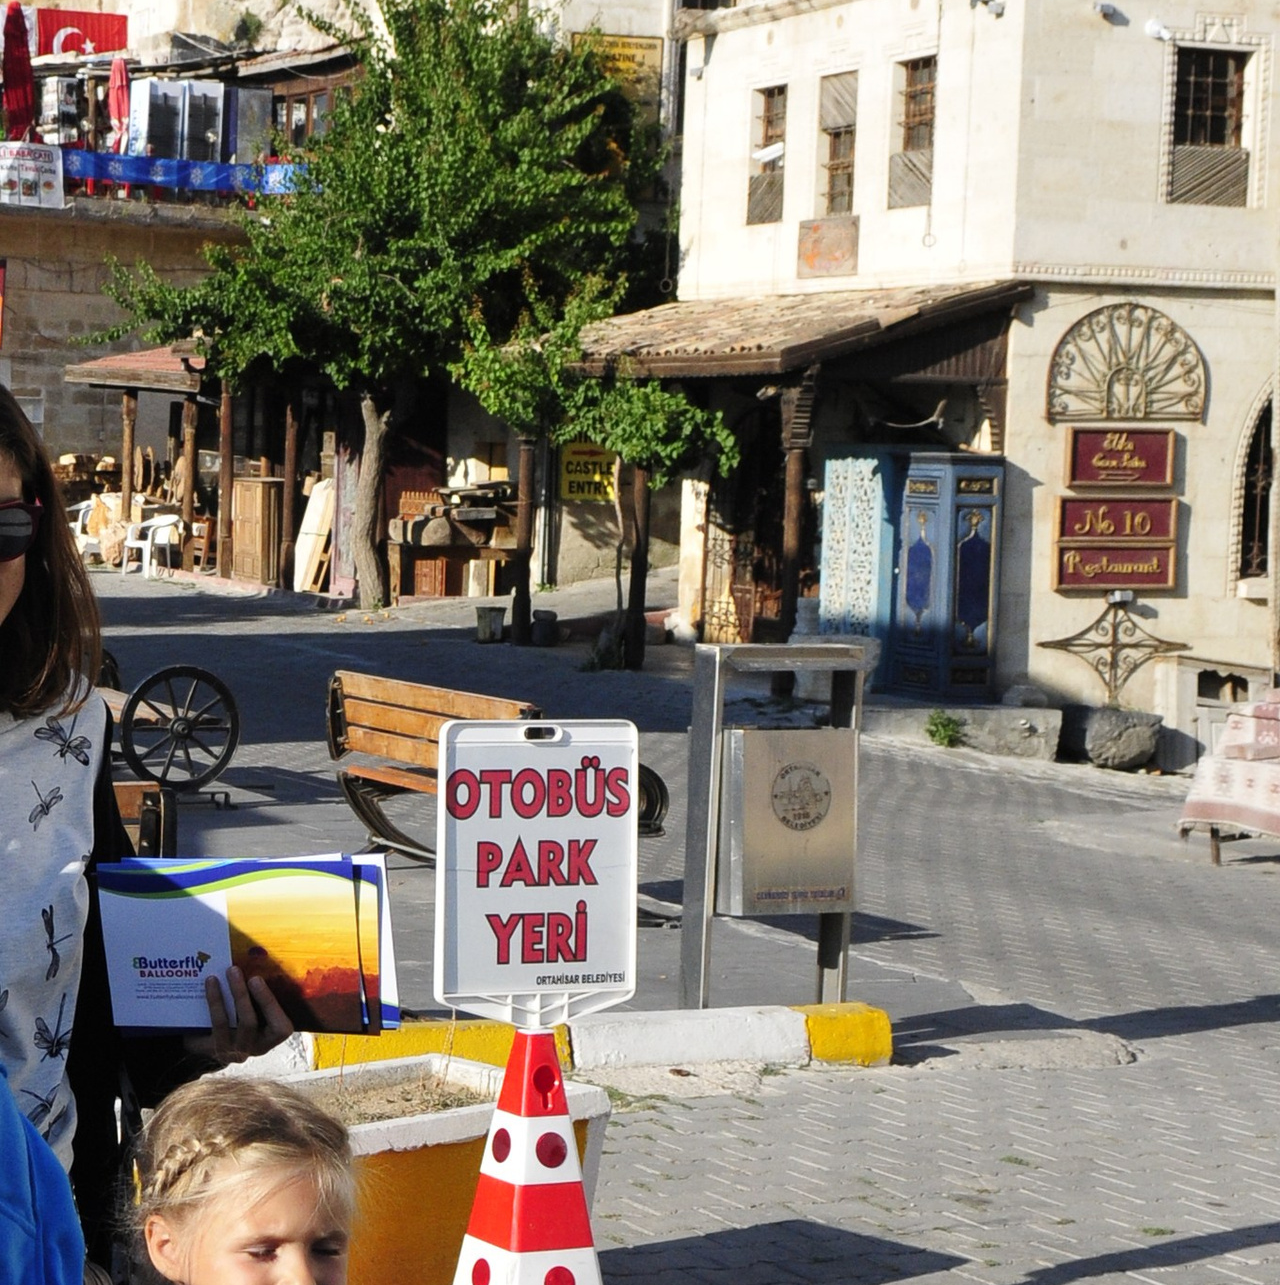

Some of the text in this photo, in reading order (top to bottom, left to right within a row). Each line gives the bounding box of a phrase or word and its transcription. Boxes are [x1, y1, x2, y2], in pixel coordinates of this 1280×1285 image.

[565, 460, 614, 475] CASTLE
[1074, 505, 1152, 536] No 10
[1063, 550, 1161, 578] Restaurant
[446, 755, 631, 821] OTOBÜS
[476, 835, 599, 888] PARK
[485, 899, 588, 965] YERİ
[135, 955, 205, 972] Butterfly
[140, 970, 199, 978] BALLOONS
[536, 971, 626, 986] ORTAHİSAR BELEDİYESİ
